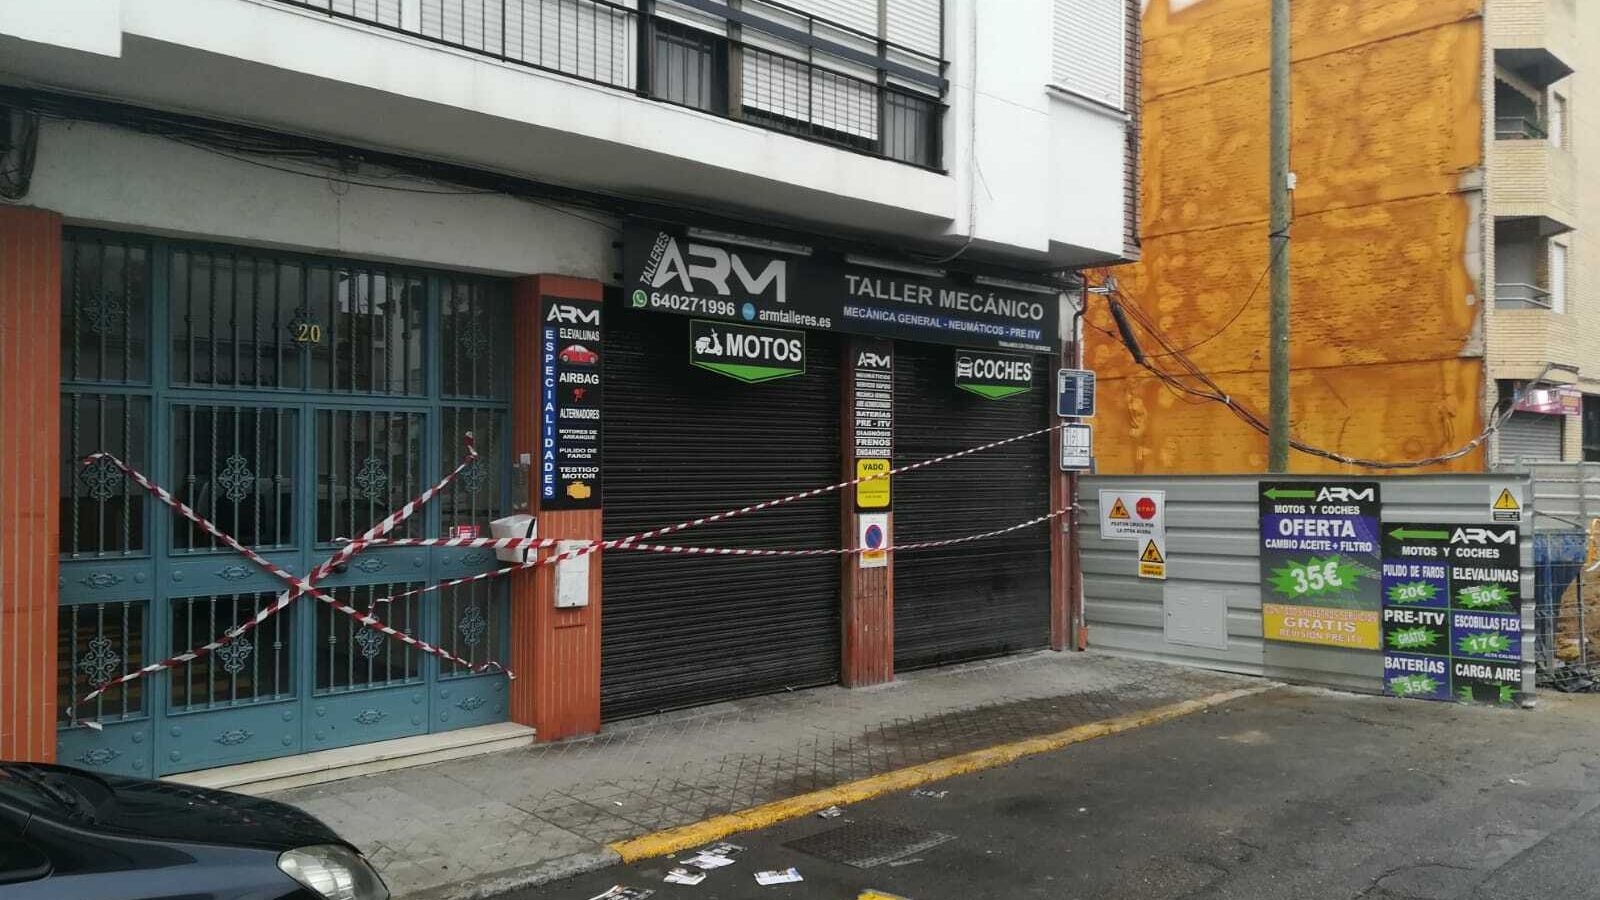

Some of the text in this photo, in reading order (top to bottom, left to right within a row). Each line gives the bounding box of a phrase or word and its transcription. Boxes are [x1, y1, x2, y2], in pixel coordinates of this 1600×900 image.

[640, 231, 670, 286] TALLERES
[652, 236, 786, 303] ARM
[651, 292, 735, 316] 640271996
[845, 275, 1044, 321] TALLER MECÁNICO
[546, 303, 600, 326] ARM
[759, 309, 832, 328] armtalleres.es
[843, 306, 896, 322] MECÁNICA
[897, 313, 941, 328] GENERAL
[948, 320, 1003, 335] NEUMÁTICOS
[1010, 328, 1026, 338] PRE
[1026, 330, 1041, 340] ITV
[298, 323, 320, 343] 20
[559, 327, 600, 341] ELEVALUNAS
[726, 333, 802, 362] MOTOS
[857, 351, 891, 369] ARM
[559, 372, 599, 385] AIRBAG
[973, 358, 1032, 382] COCHES
[544, 329, 555, 496] ESPECIALIDADES
[559, 408, 600, 420] ALTERNADORES
[855, 419, 872, 427] PRE
[877, 420, 891, 428] ITV
[855, 438, 891, 446] FRENOS
[855, 448, 891, 456] ENGANCHES
[863, 463, 884, 471] VADO
[1316, 486, 1375, 502] ARM
[1274, 504, 1360, 515] MOTOS Y COCHES
[1279, 518, 1357, 538] OFERTA
[1449, 527, 1517, 546] ARM
[1265, 538, 1298, 549] CAMBIO
[1299, 539, 1331, 551] ACEITE
[1340, 541, 1373, 552] FILTRO
[1401, 545, 1500, 559] MOTOS Y COCHES
[1290, 561, 1343, 594] 35€
[1383, 564, 1445, 579] PULIDO DE FAROS
[1452, 567, 1519, 582] ELEVALUNAS
[1398, 584, 1427, 600] 20€
[1471, 589, 1503, 604] 50€
[1283, 616, 1357, 633] GRATIS
[1384, 609, 1445, 626] PRE-ITV
[1454, 614, 1521, 632] ESCOBILLAS FLEX
[1398, 630, 1426, 645] GRATIS
[1470, 635, 1500, 651] 17€
[1384, 656, 1445, 675] BATERÍAS
[1455, 663, 1521, 682] CARGA AIRE
[1403, 679, 1433, 694] 35€
